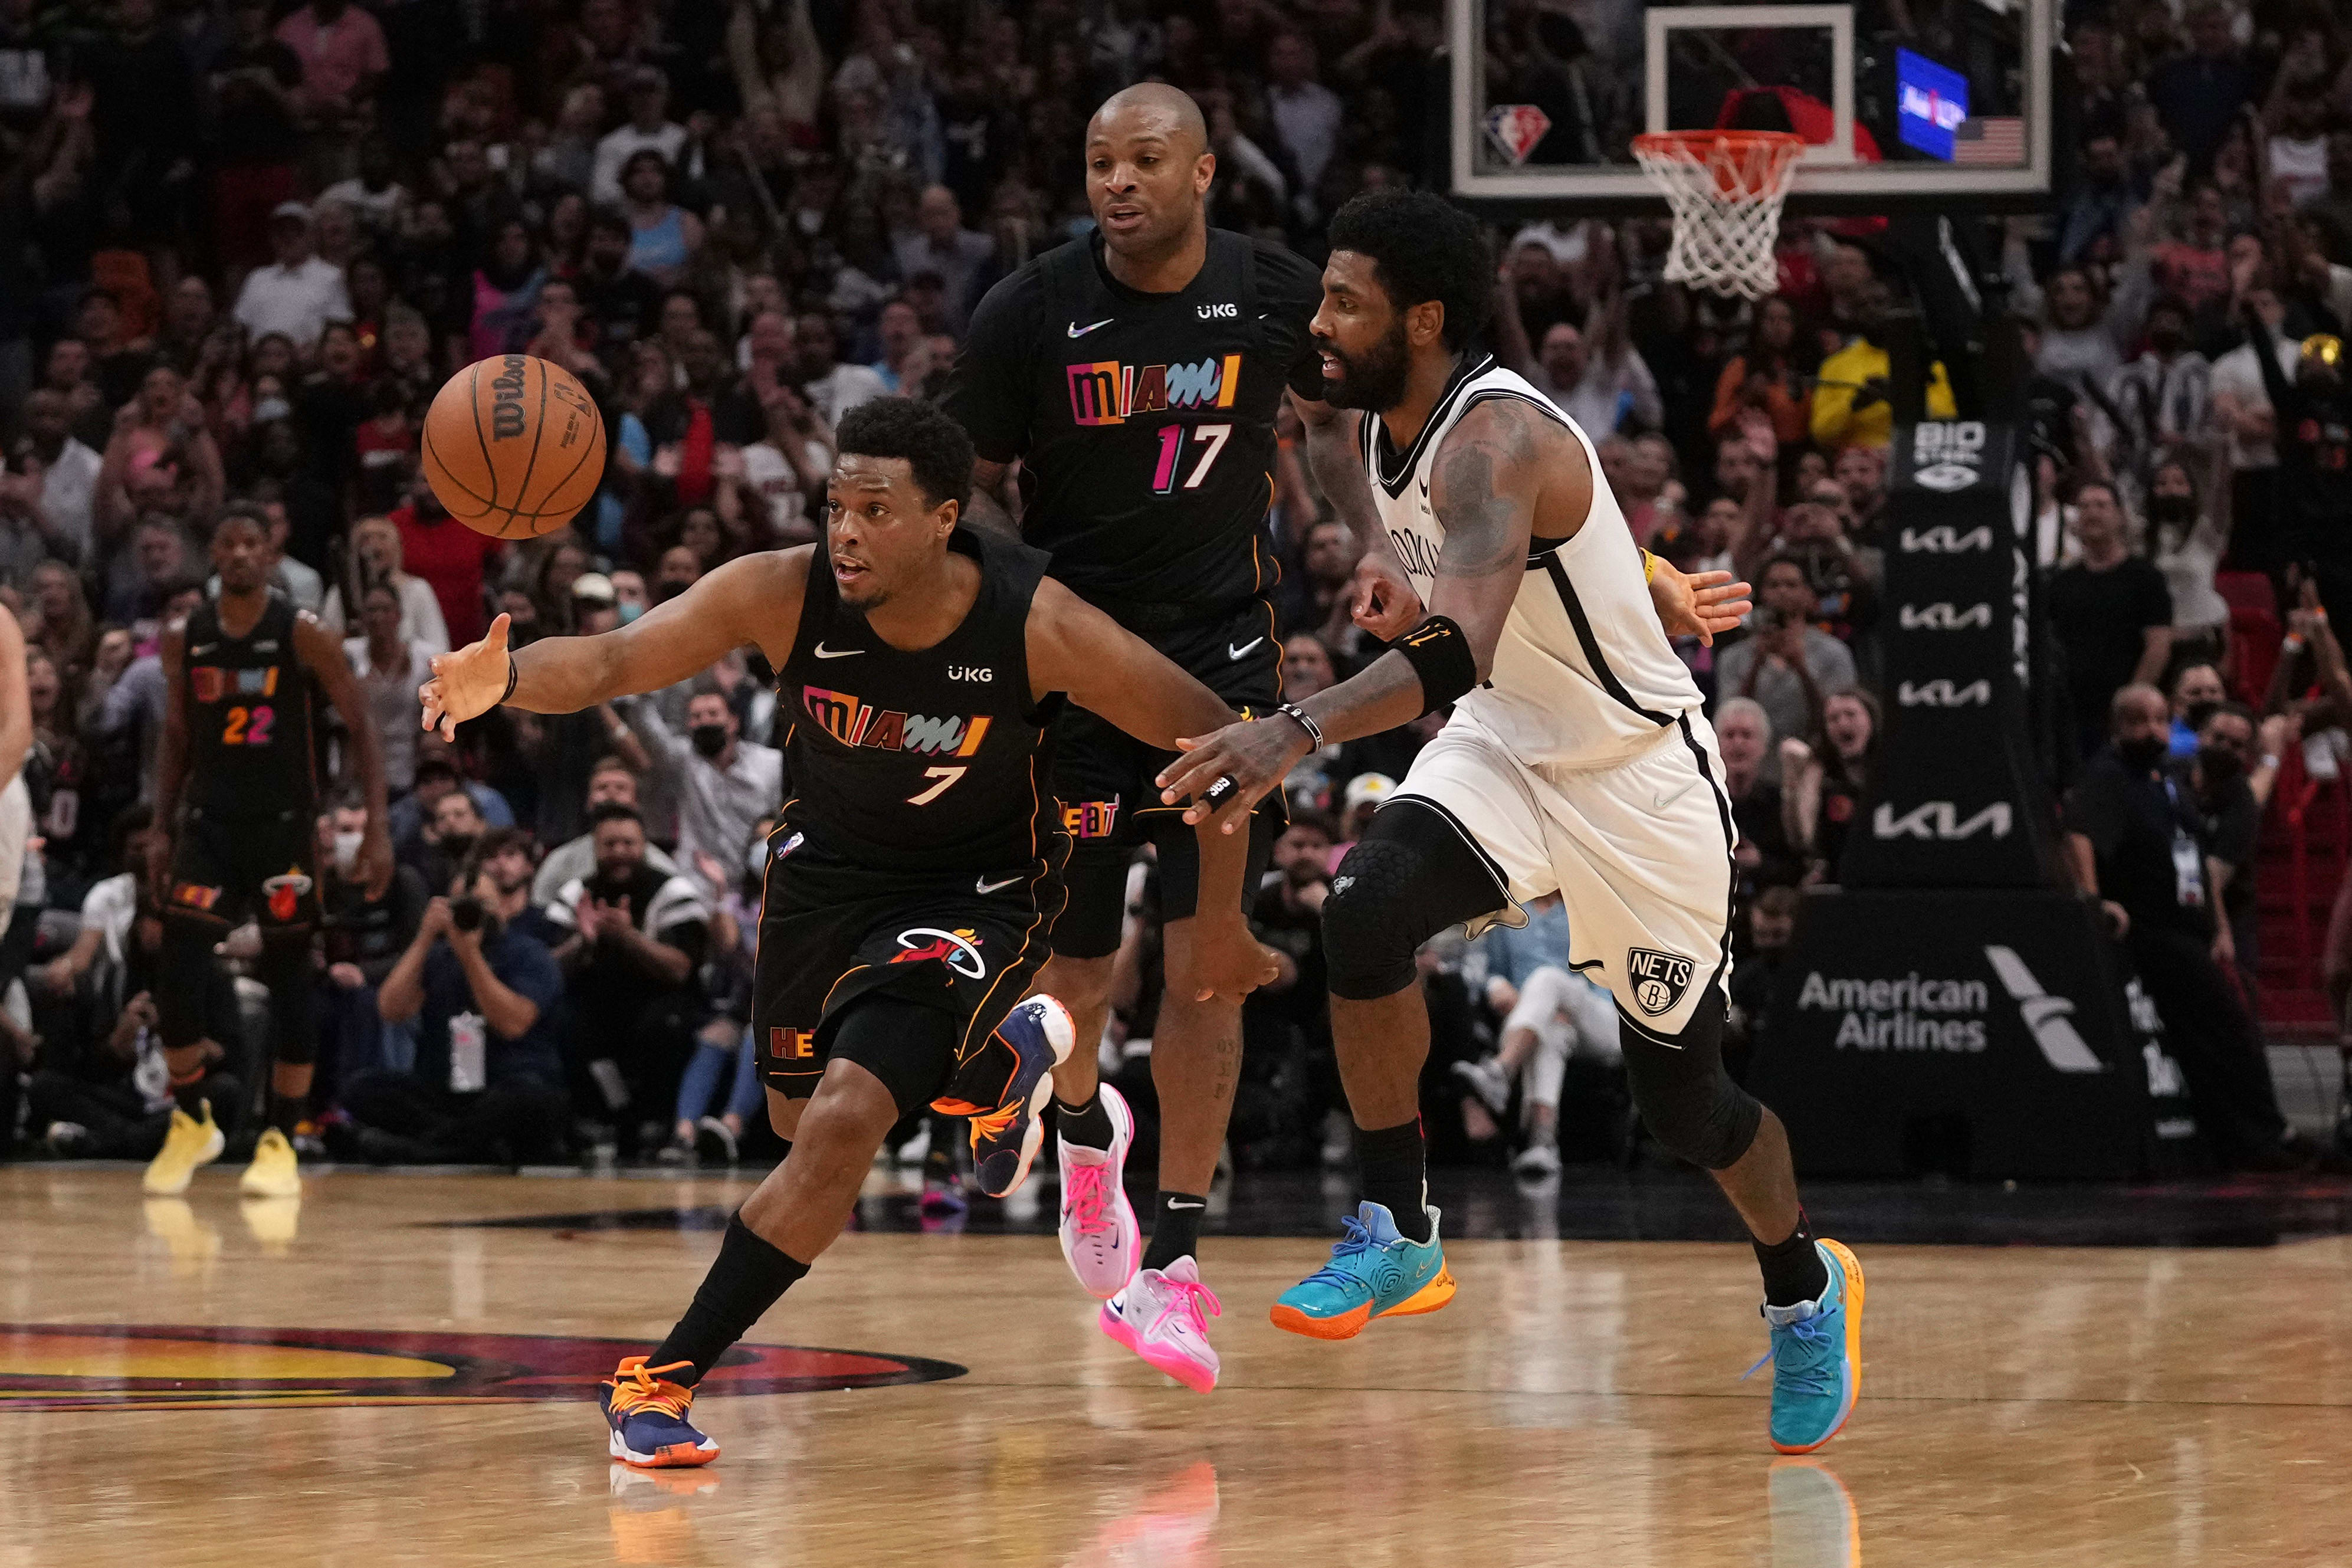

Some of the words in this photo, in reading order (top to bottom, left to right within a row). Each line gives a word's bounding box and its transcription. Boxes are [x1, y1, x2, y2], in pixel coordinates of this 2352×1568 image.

[1066, 353, 1242, 426] MIAMI
[1153, 424, 1232, 494] 17
[222, 706, 275, 745] 22
[803, 685, 993, 757] MIAMI
[906, 766, 968, 806] 7
[1631, 952, 1690, 987] NETS
[1646, 985, 1660, 1006] B
[1797, 971, 1988, 1012] American
[770, 1026, 815, 1060] HE
[1835, 1012, 1987, 1052] Airlines
